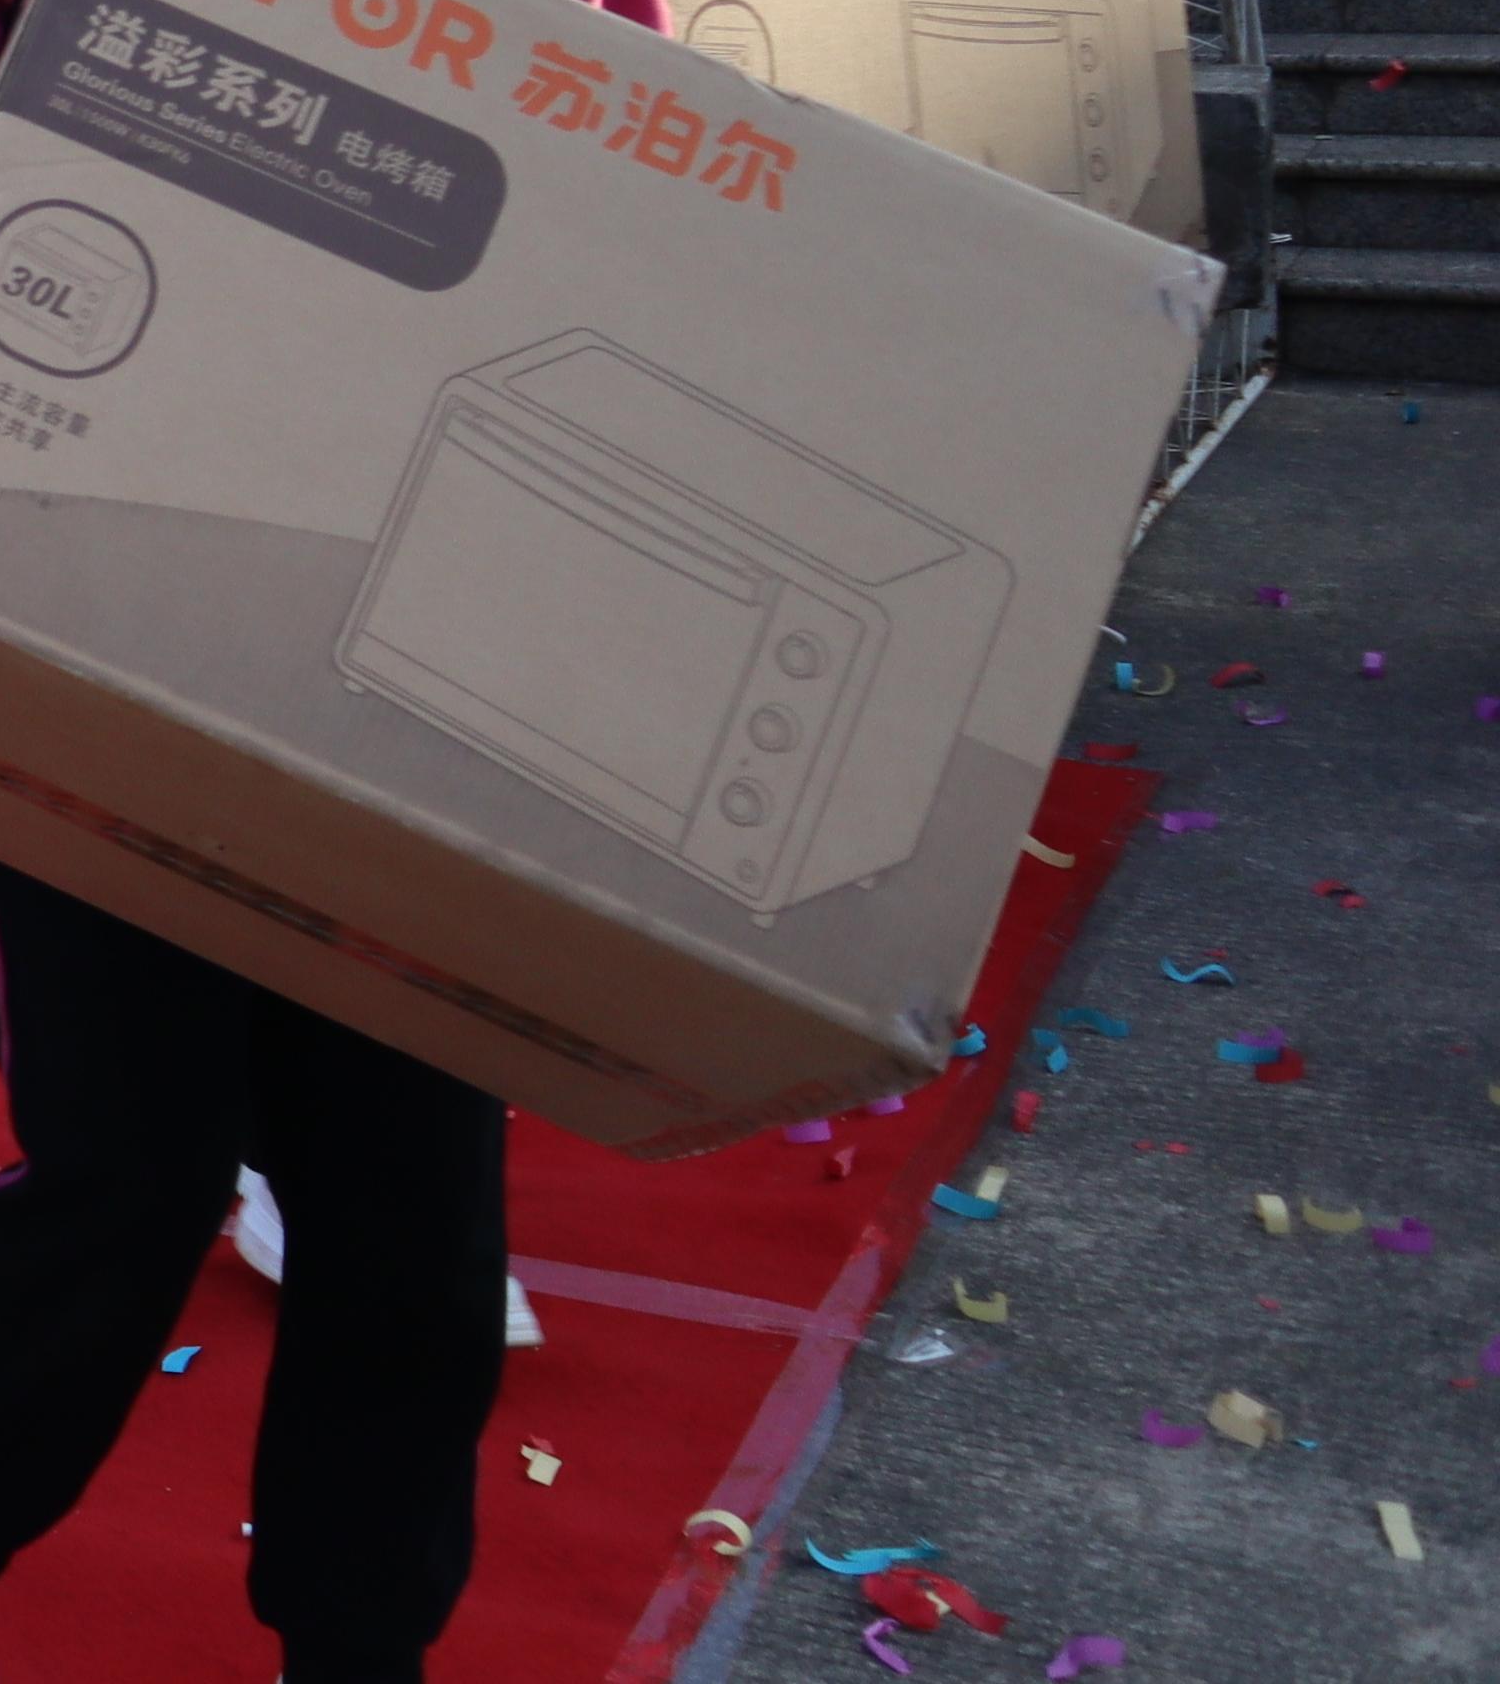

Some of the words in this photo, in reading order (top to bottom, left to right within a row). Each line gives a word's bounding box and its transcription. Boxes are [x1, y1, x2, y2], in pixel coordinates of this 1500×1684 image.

[61, 60, 154, 114] Glorious
[158, 100, 228, 146] Series
[228, 130, 308, 182] Electric
[313, 166, 374, 208] Oven
[77, 4, 330, 146] 溢彩系列
[336, 129, 457, 204] 电烤箱
[510, 41, 798, 213] 苏泊尔
[2, 266, 73, 320] 30L
